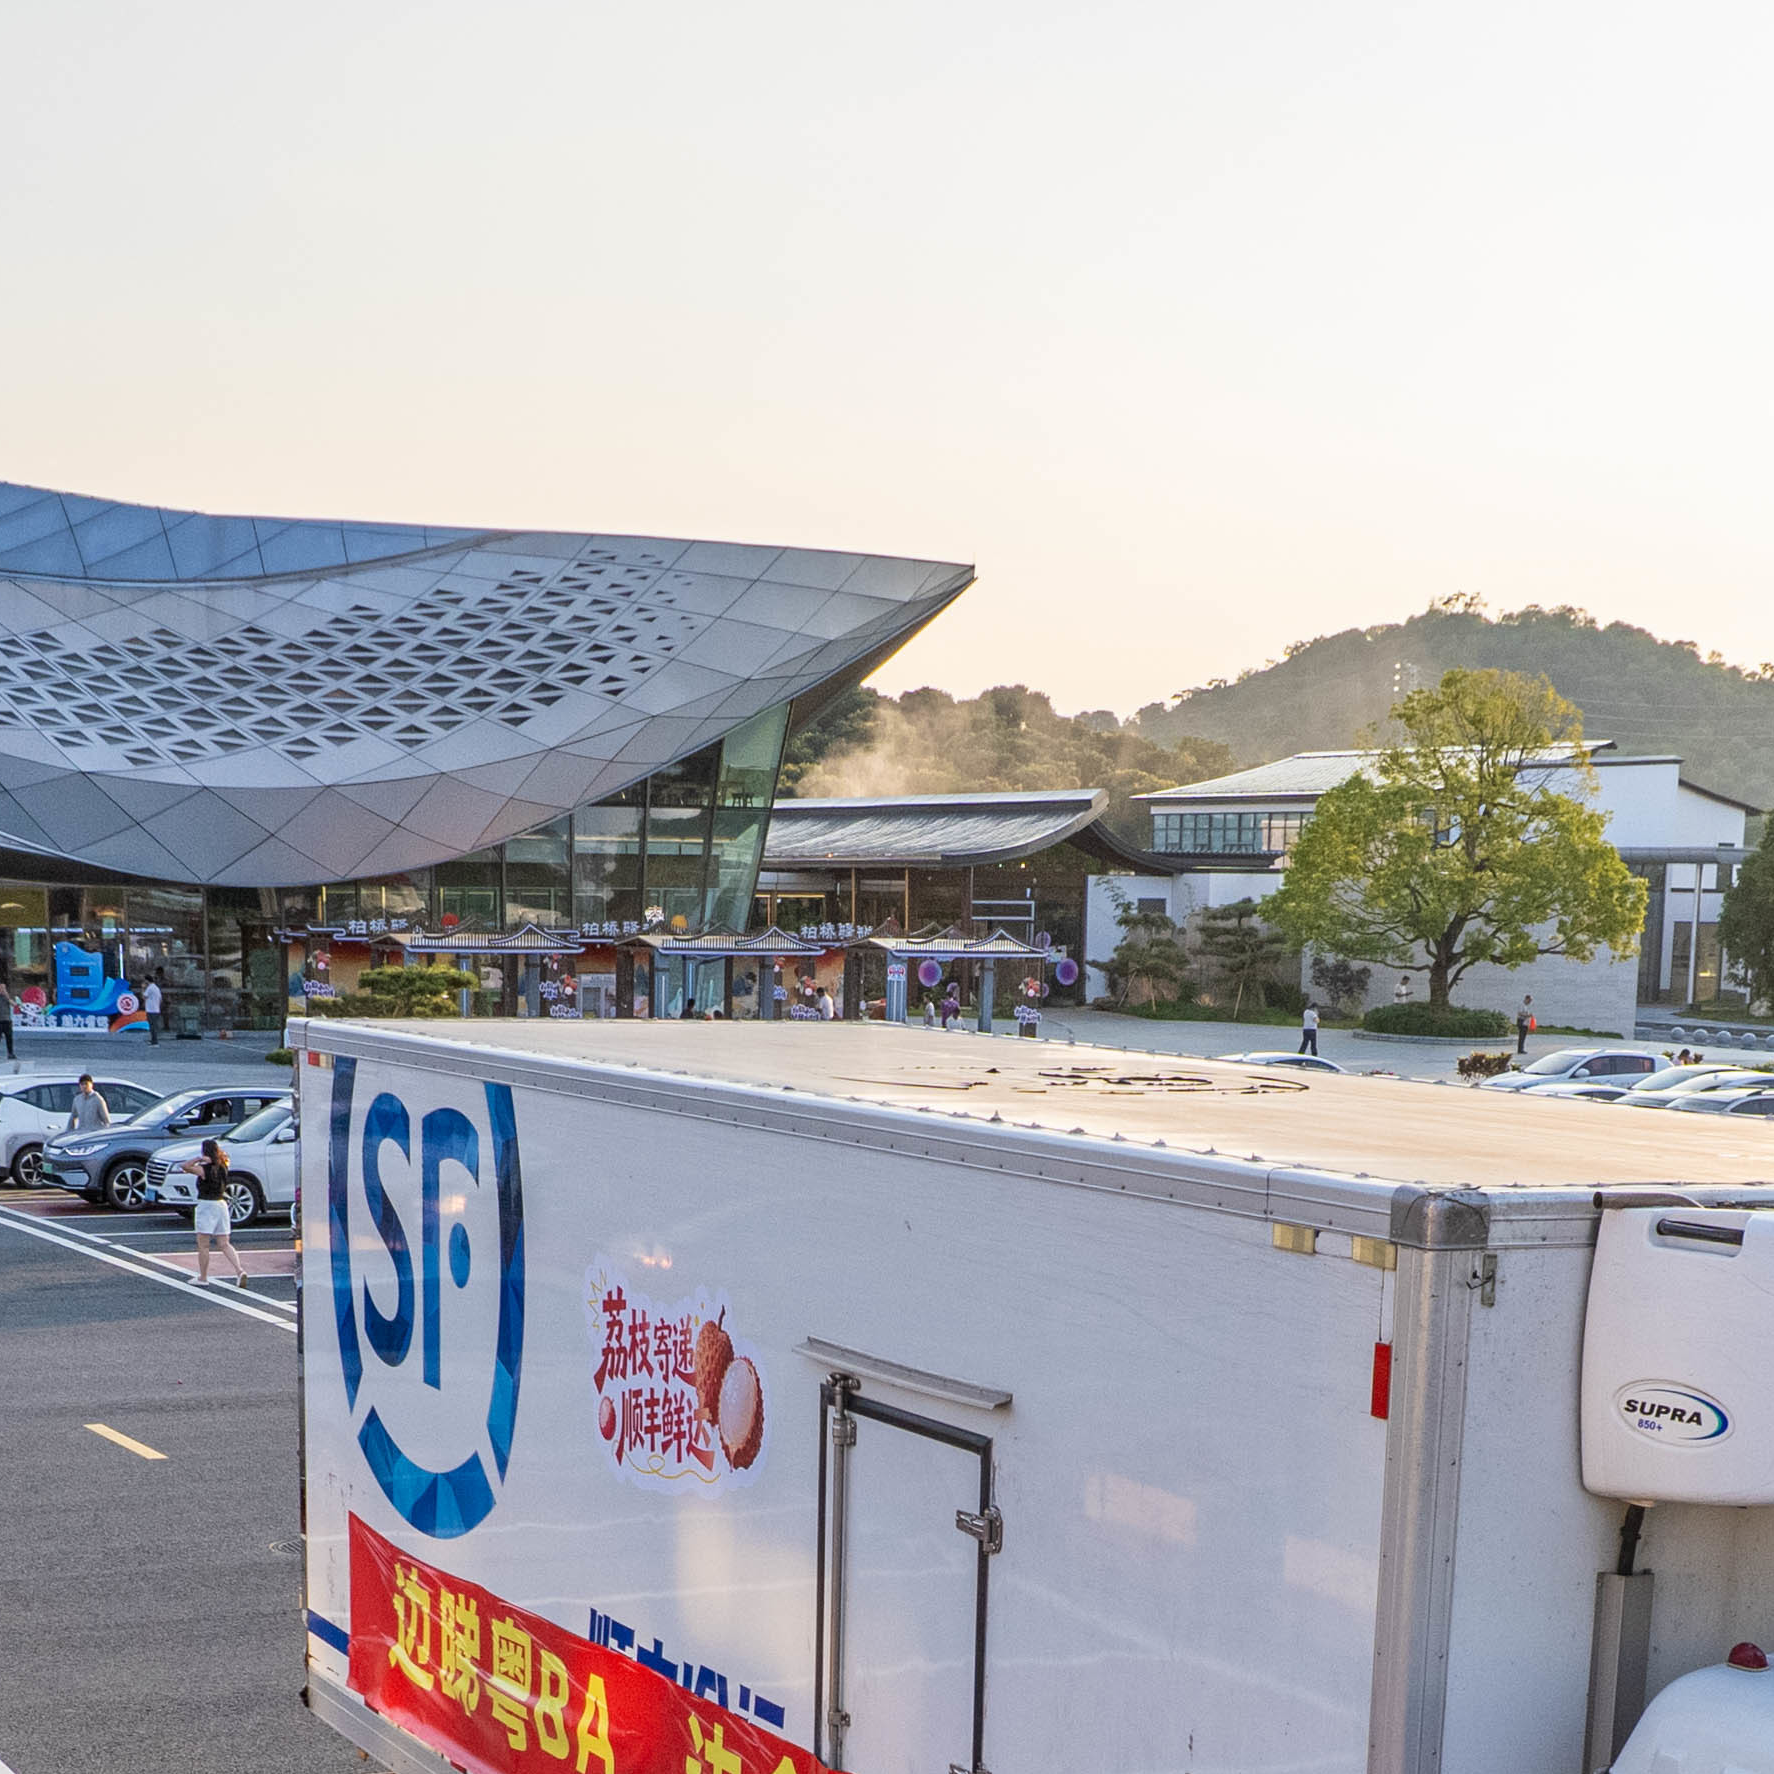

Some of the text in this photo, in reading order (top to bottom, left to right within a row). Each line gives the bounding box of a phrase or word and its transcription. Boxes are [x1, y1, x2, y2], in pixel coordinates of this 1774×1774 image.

[594, 1285, 698, 1395] 荔枝寄递
[615, 1387, 716, 1472] 顺丰鲜达
[1624, 1399, 1703, 1427] SUPRA
